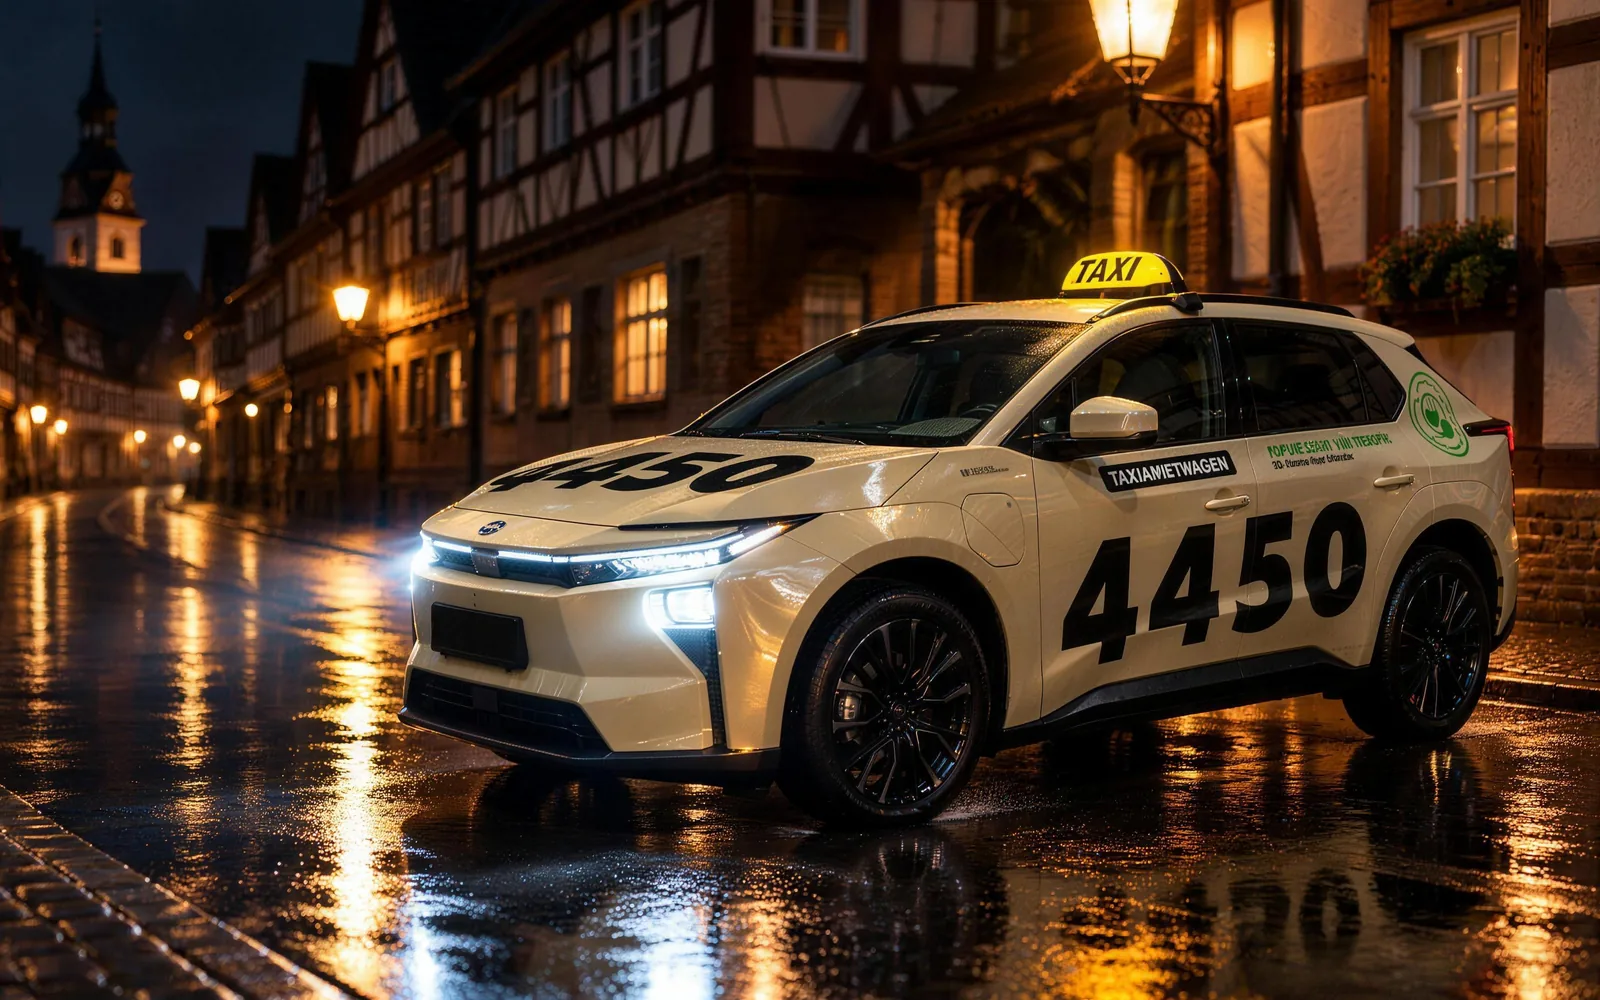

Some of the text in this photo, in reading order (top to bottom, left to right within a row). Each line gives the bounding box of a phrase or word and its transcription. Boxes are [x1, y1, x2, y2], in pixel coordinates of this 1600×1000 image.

[1075, 256, 1143, 284] TAXI
[488, 451, 815, 494] 4450
[1107, 455, 1230, 488] TAXIAMIETWAGEN
[1061, 501, 1367, 665] 4450
